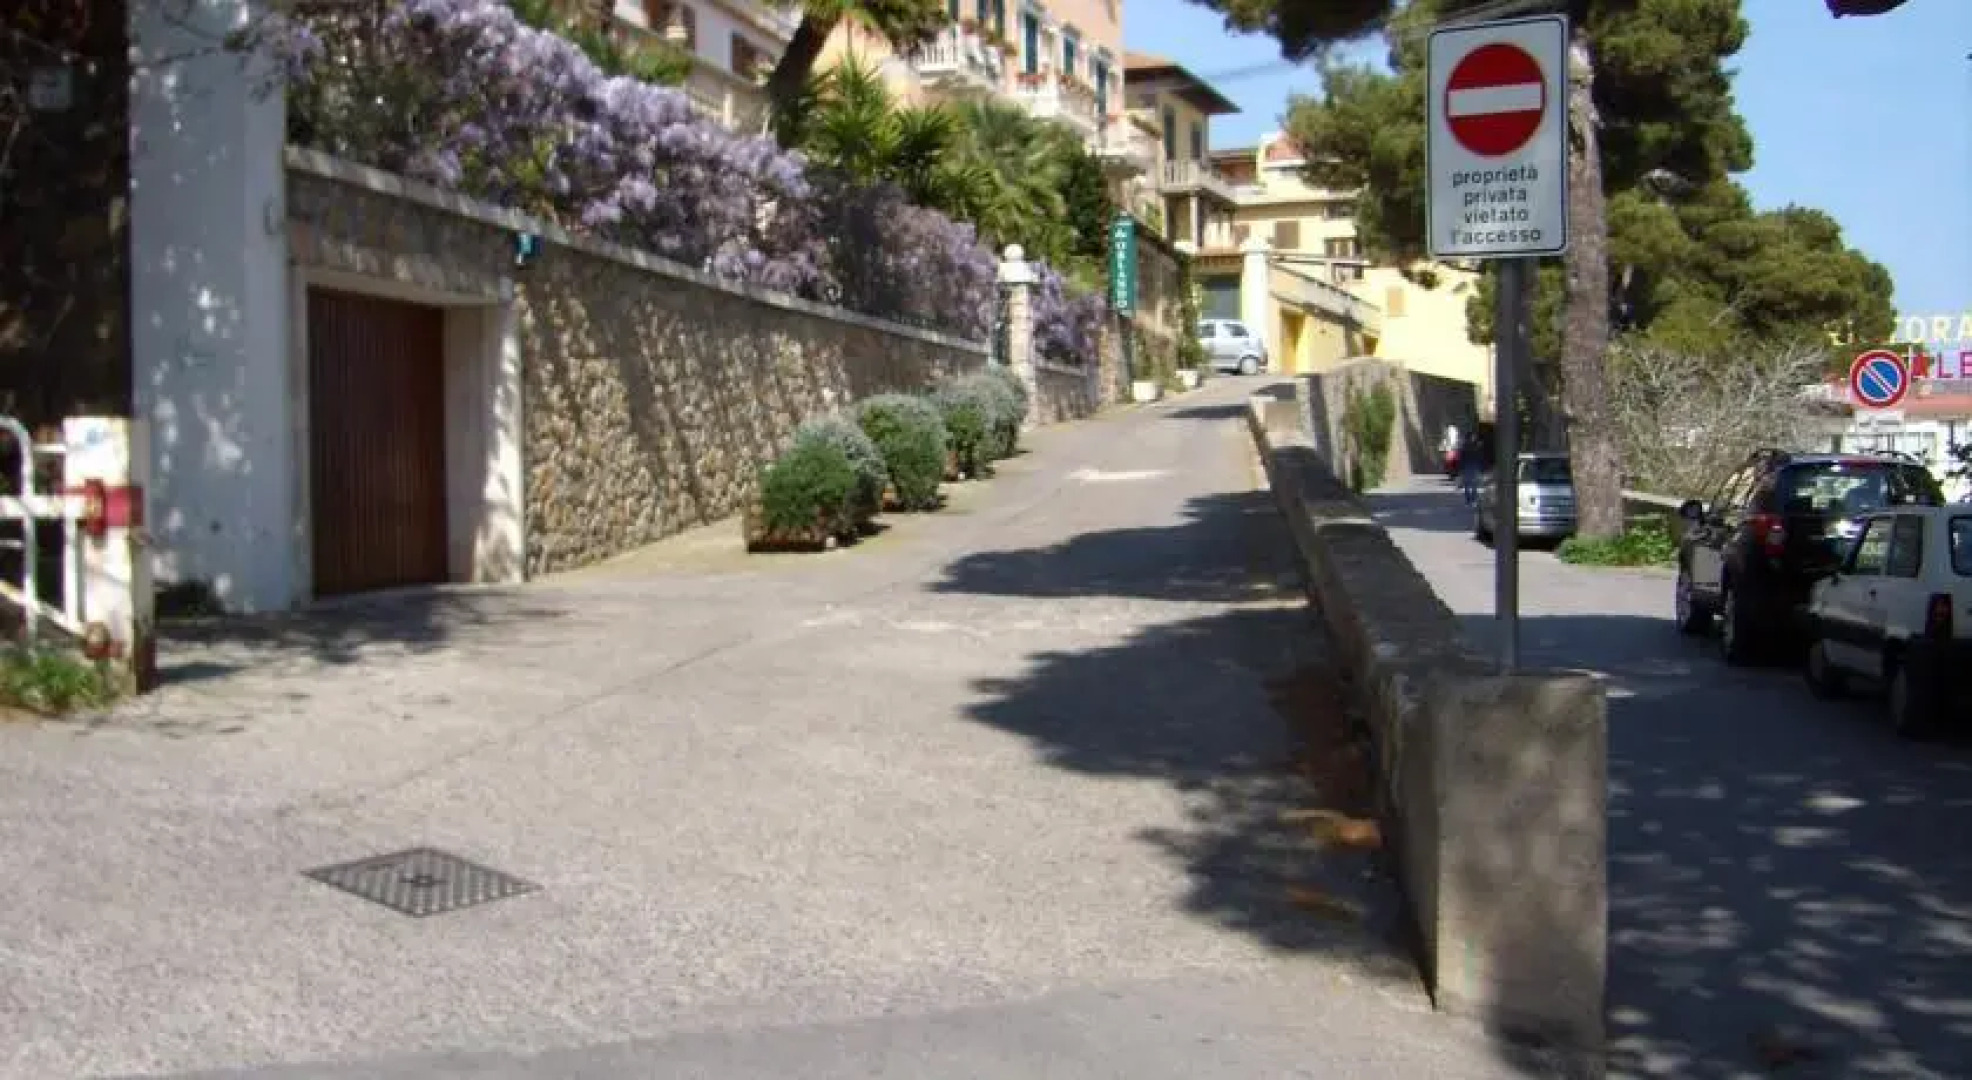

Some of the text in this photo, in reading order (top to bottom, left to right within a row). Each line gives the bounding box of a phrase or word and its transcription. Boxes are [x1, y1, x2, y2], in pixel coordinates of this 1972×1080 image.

[1452, 162, 1539, 189] proprietà
[1464, 187, 1527, 206] privata
[1464, 206, 1529, 224] vietato
[1449, 228, 1541, 245] l'accesso
